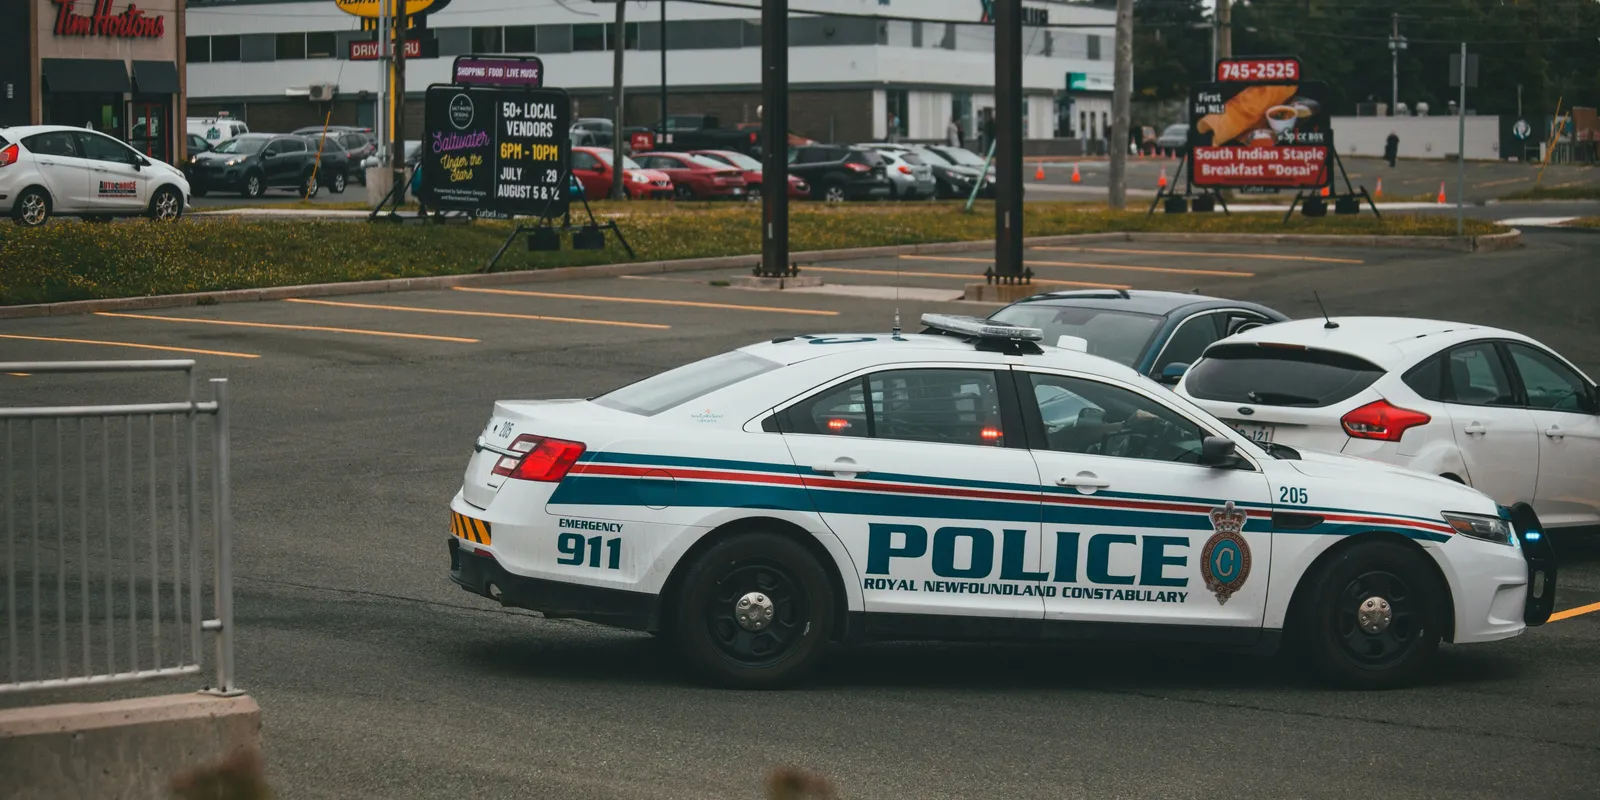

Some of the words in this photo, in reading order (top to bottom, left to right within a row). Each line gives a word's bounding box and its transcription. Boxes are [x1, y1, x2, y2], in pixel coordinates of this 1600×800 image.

[51, 0, 90, 35] Tim
[91, 0, 164, 38] Hortons
[352, 44, 379, 57] DRIV
[458, 67, 485, 77] SHOPPING
[488, 68, 504, 77] FOOD
[506, 69, 519, 78] LIVE
[520, 69, 538, 78] MUSIC
[1222, 63, 1295, 79] 745-2525
[1198, 93, 1222, 103] First
[503, 102, 522, 118] 50+
[524, 103, 557, 119] LOCAL
[1195, 104, 1206, 113] in
[1208, 104, 1225, 113] NL!
[506, 121, 553, 138] VENDORS
[432, 130, 490, 153] Saltwater
[501, 143, 522, 159] 6PM
[532, 144, 558, 161] 10PM
[1196, 148, 1233, 160] South
[1237, 148, 1278, 160] Indian
[1283, 148, 1324, 163] Staple
[440, 154, 468, 169] Under
[469, 154, 483, 166] the
[1202, 163, 1264, 176] Breakfast
[450, 168, 473, 182] Stars
[500, 167, 522, 180] JULY
[546, 169, 557, 182] 29
[498, 184, 531, 198] AUGUST
[533, 186, 539, 199] 5
[541, 187, 548, 200] &
[1280, 486, 1308, 504] 205
[559, 518, 623, 533] EMERGENCY
[557, 532, 622, 569] 911
[865, 523, 1190, 587] POLICE
[864, 578, 918, 592] ROYAL
[923, 580, 1057, 597] NEWFOUNDLAND
[1062, 586, 1189, 603] CONSTABULARY
